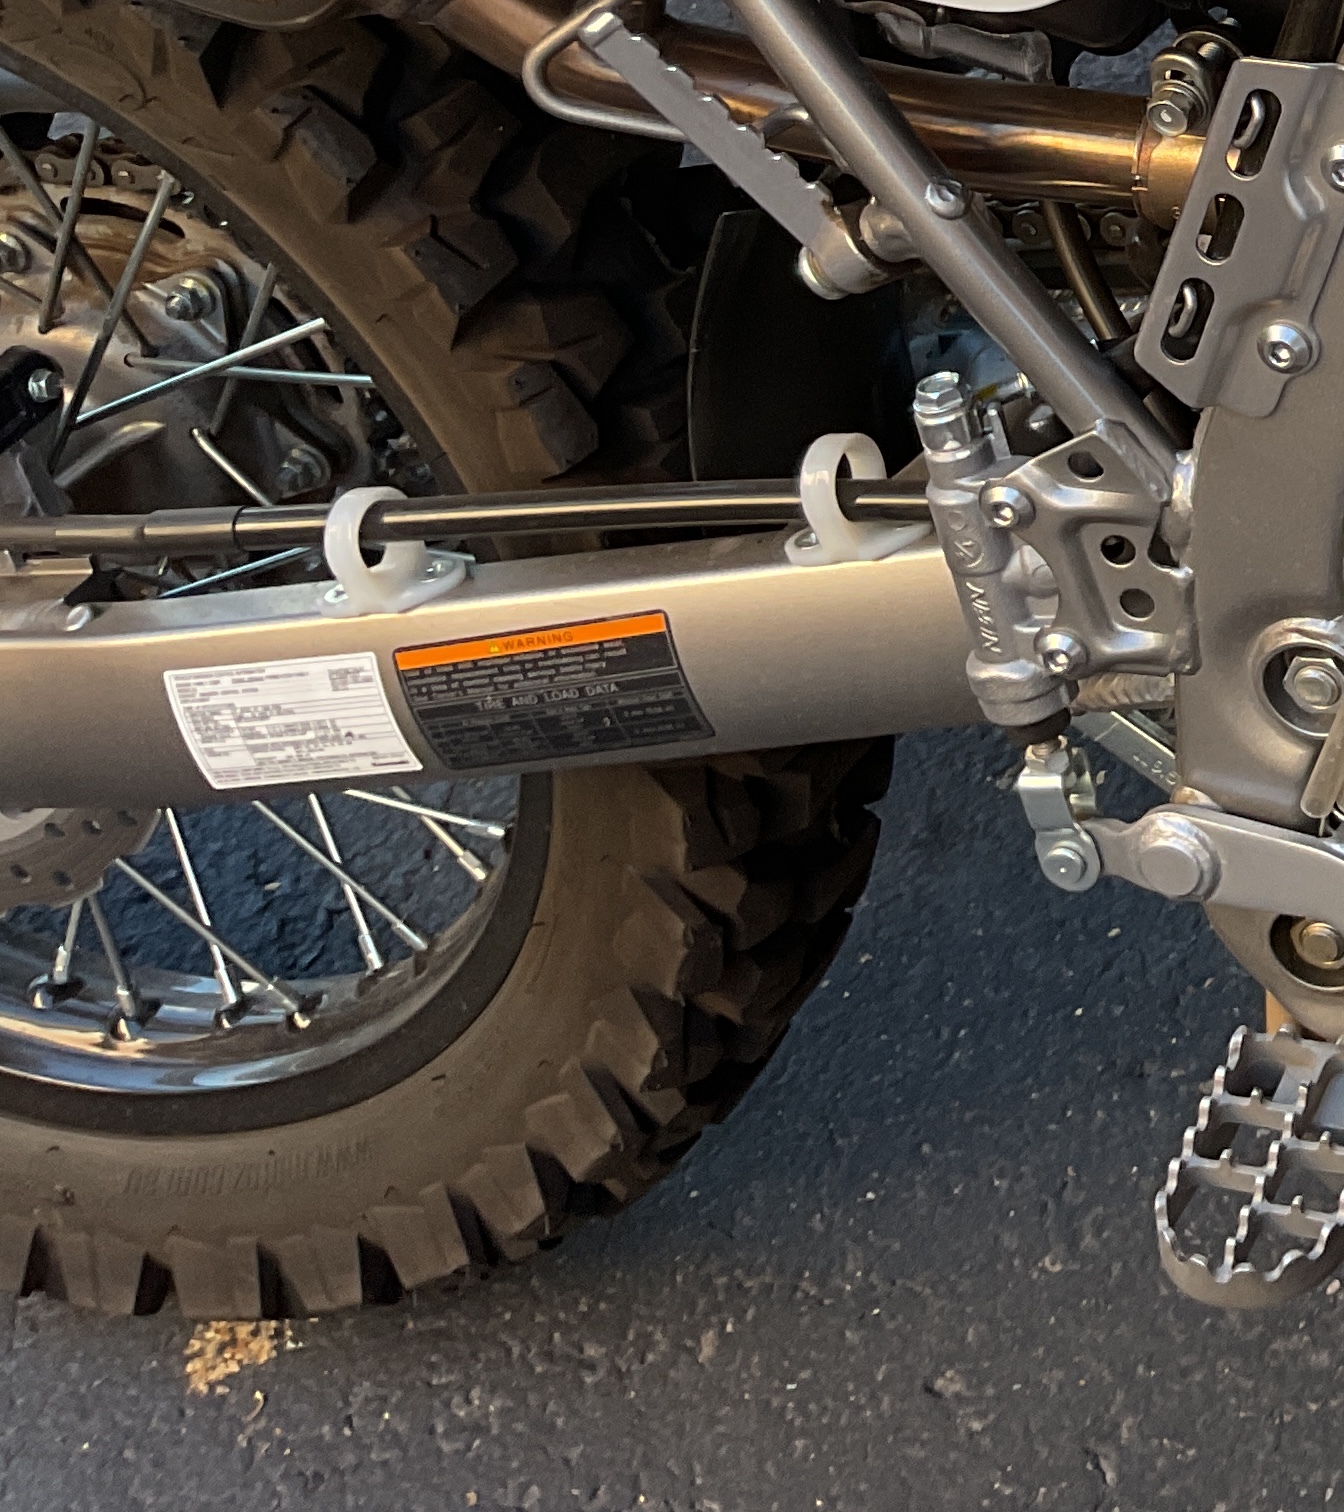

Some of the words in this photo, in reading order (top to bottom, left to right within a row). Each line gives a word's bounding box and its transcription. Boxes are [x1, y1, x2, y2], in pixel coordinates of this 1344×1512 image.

[964, 581, 1004, 654] NISSIN
[502, 630, 574, 651] WARNING
[511, 694, 538, 707] AND
[543, 688, 580, 702] LOAD
[585, 682, 620, 697] DATA
